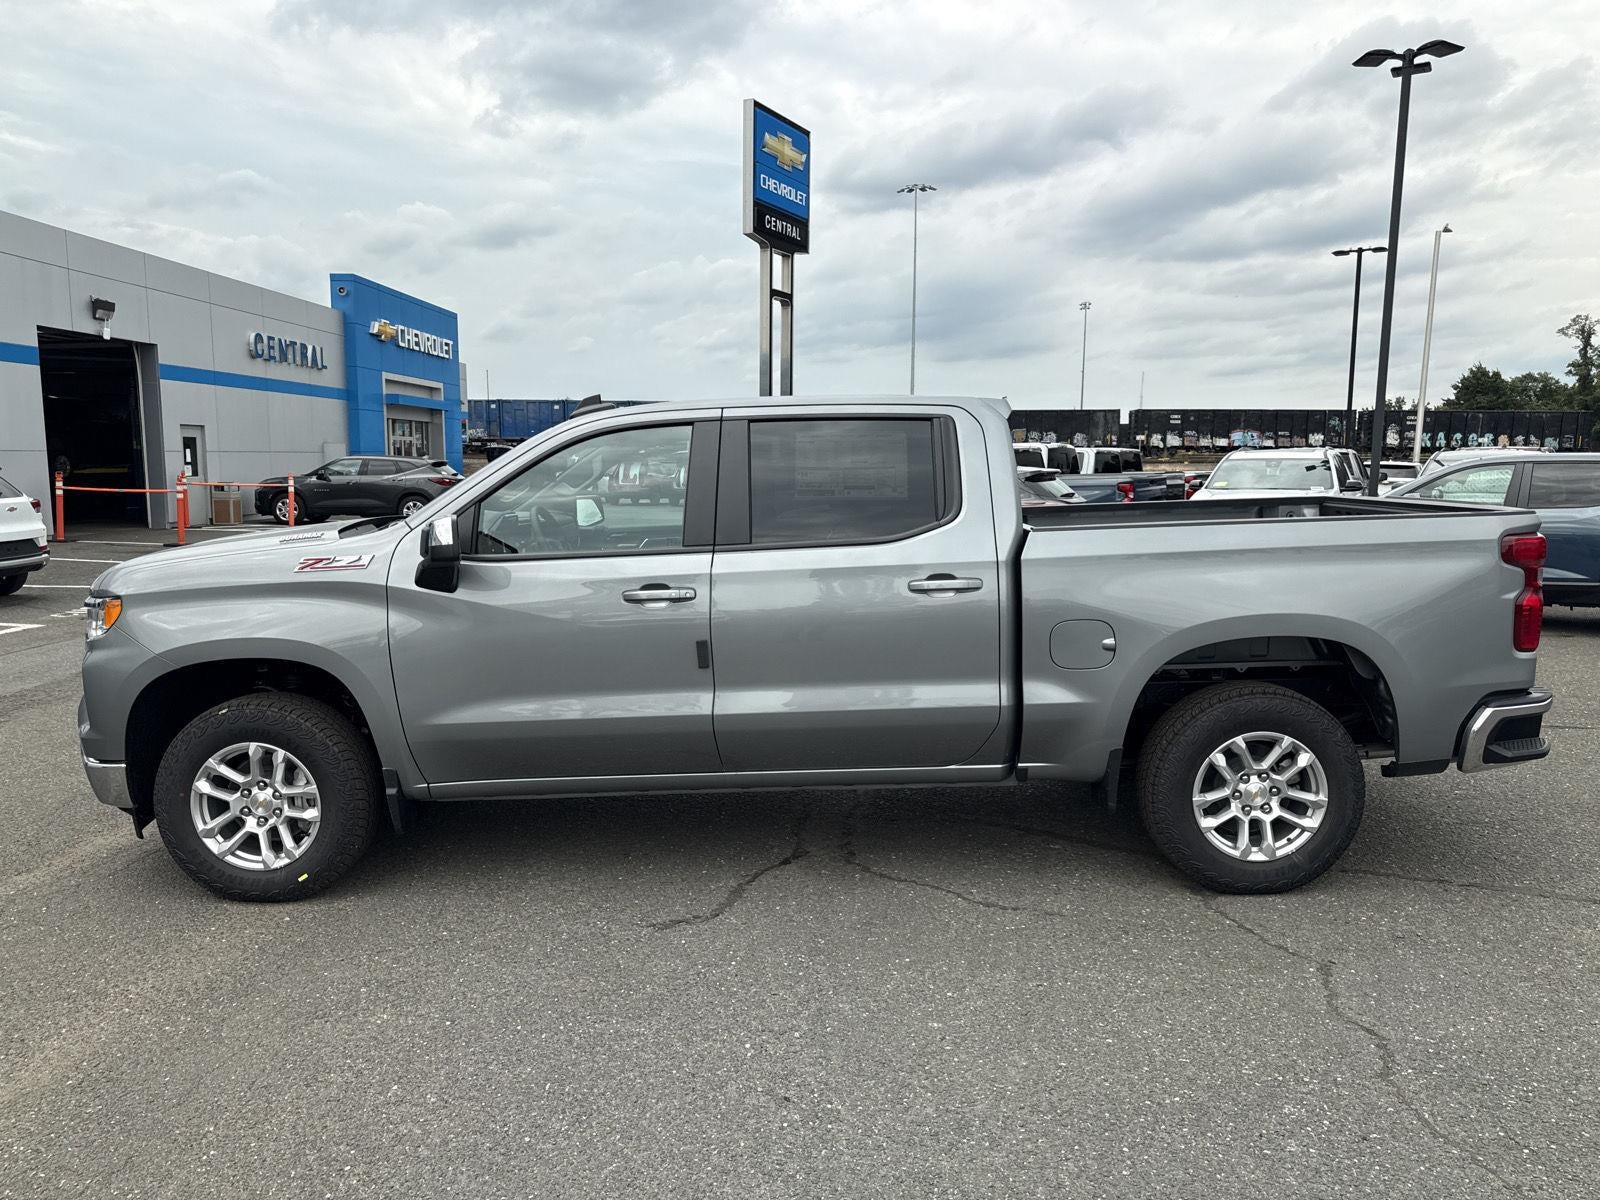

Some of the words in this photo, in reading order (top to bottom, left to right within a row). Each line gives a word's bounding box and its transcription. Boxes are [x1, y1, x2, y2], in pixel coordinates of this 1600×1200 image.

[760, 173, 807, 206] CHEVROLET
[765, 215, 801, 241] CENTRAL
[249, 332, 327, 370] CENTRAL
[396, 324, 454, 360] CHEVROLET
[294, 554, 375, 573] Z71
